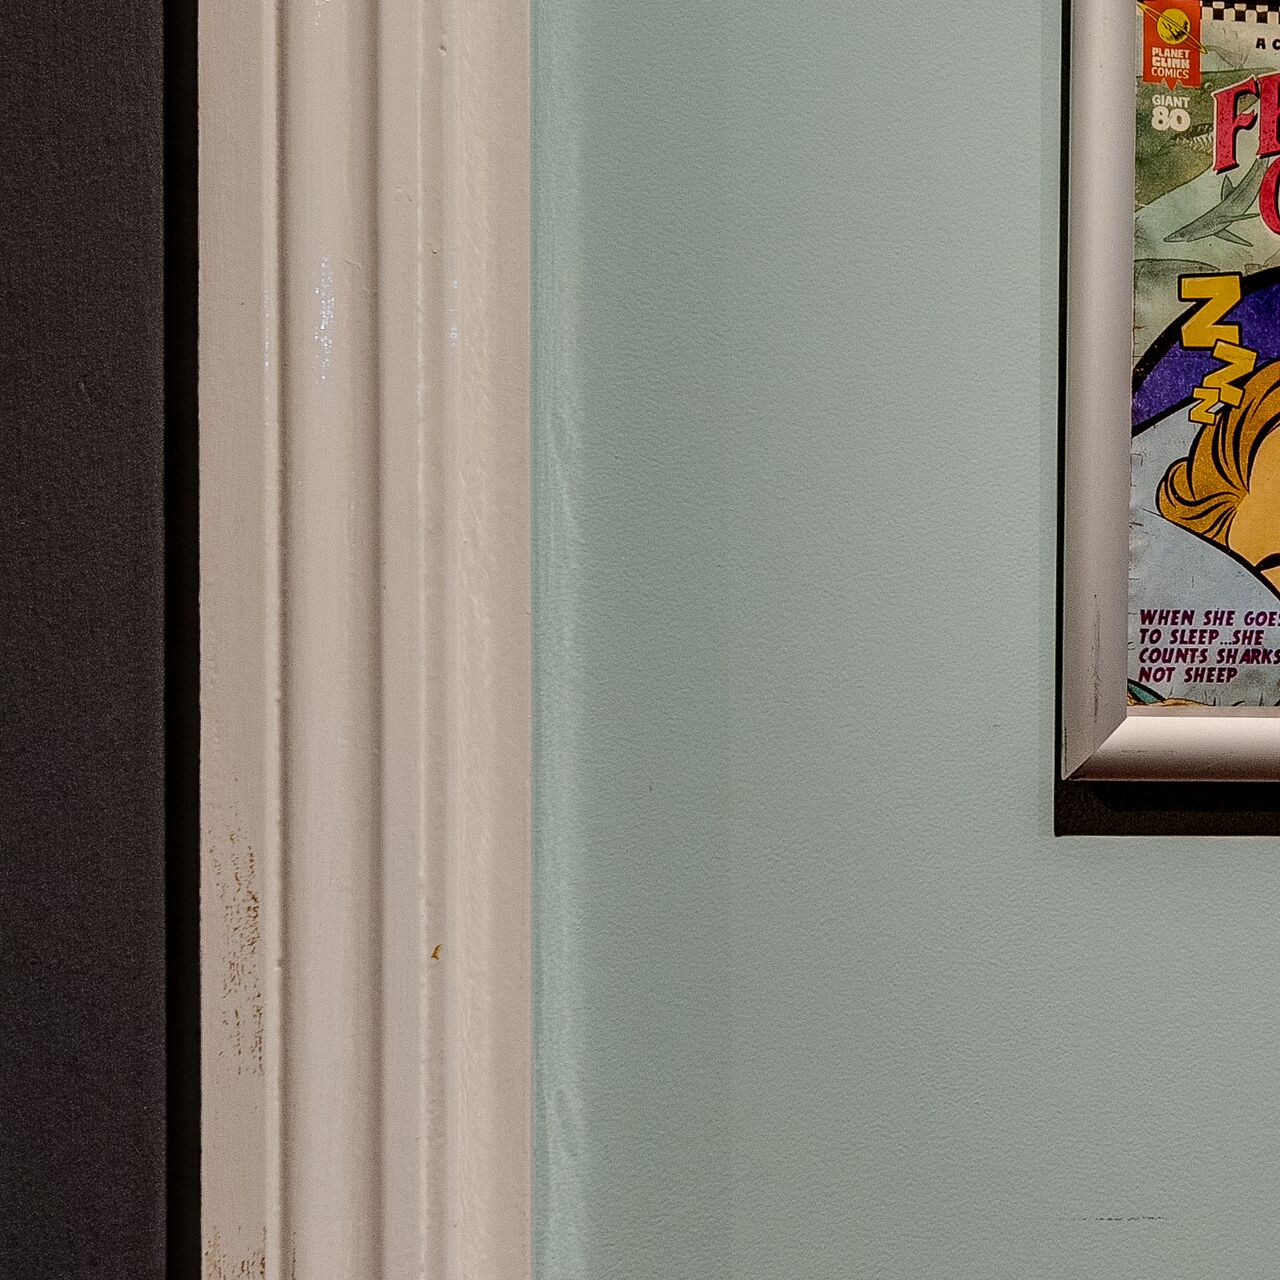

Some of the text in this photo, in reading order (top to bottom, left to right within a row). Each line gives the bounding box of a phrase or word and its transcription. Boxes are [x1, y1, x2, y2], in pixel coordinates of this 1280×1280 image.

[1255, 38, 1266, 49] A
[1152, 47, 1190, 59] PLANET
[1151, 67, 1189, 79] COMICS
[1152, 94, 1190, 108] GIANT
[1151, 106, 1191, 131] 80
[1139, 609, 1195, 626] WHEN
[1203, 610, 1235, 626] SHE
[1139, 629, 1162, 645] TO
[1139, 647, 1208, 664] COUNTS
[1138, 667, 1238, 683] NOT SHEEP
